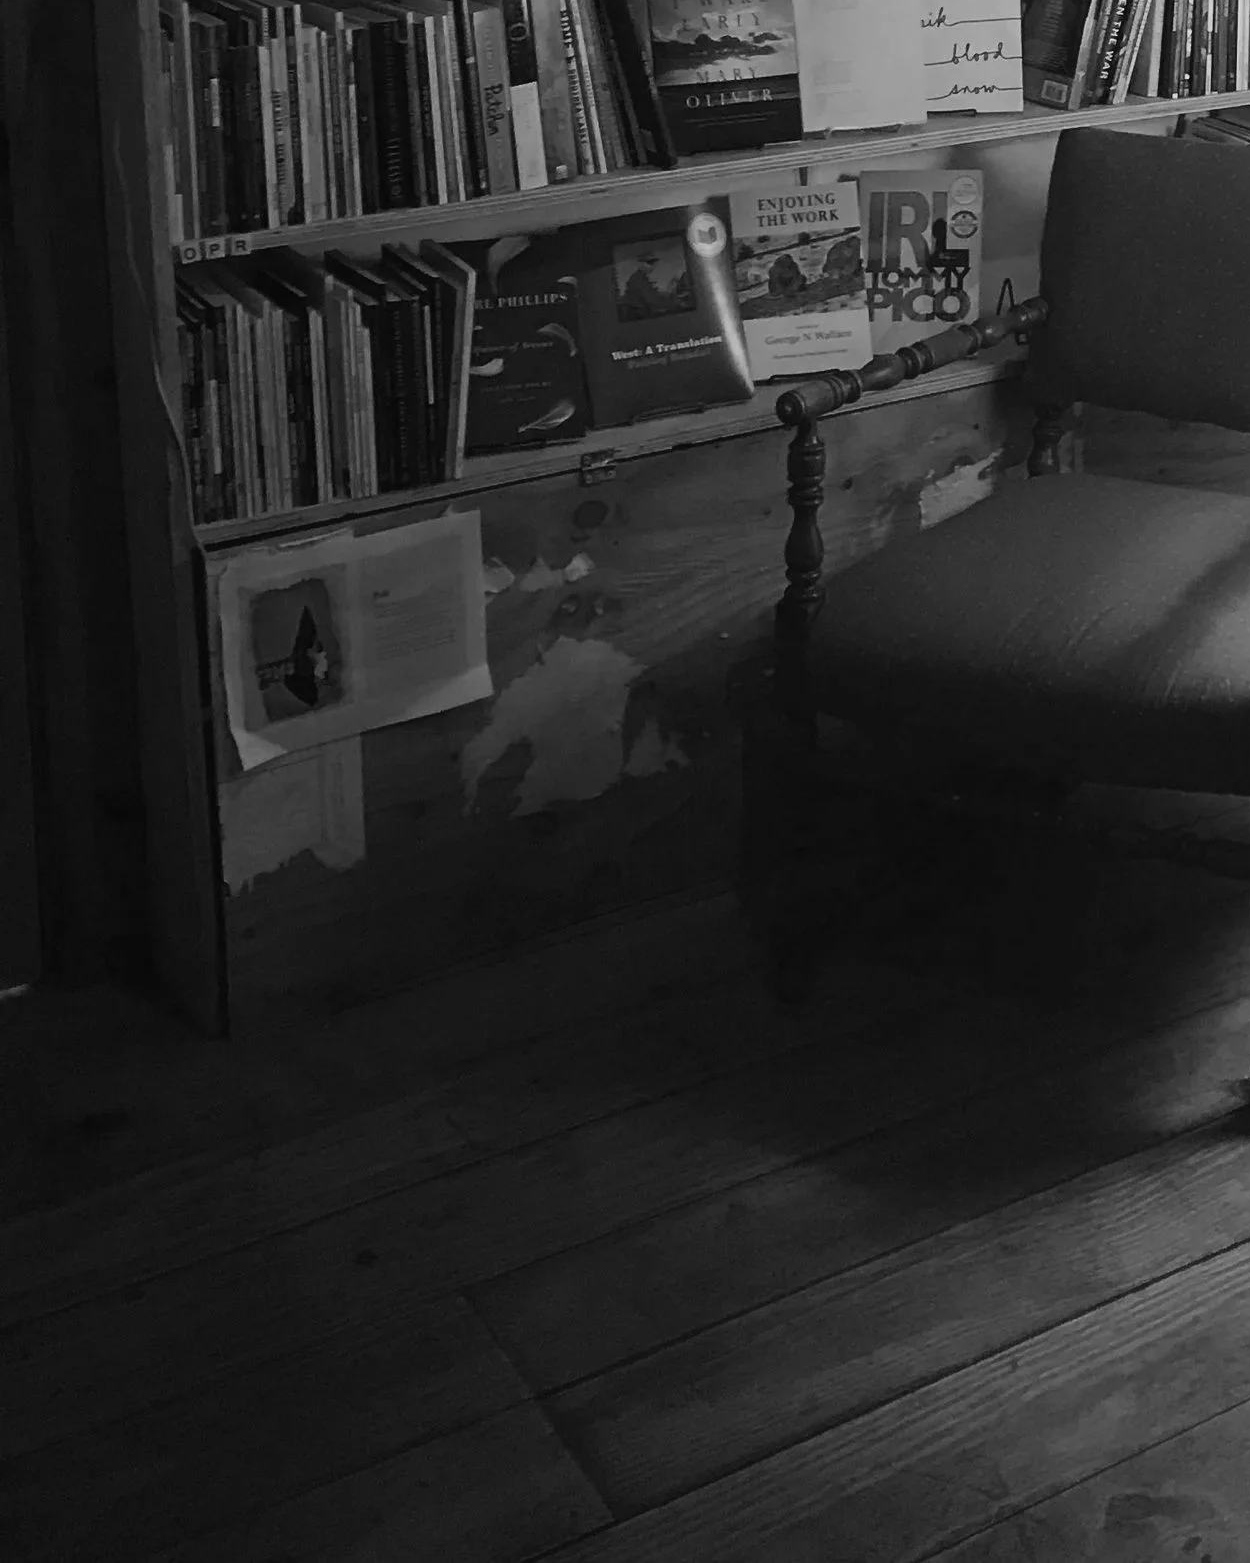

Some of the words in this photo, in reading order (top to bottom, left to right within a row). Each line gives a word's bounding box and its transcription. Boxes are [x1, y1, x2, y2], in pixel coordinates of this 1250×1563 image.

[681, 12, 761, 31] EARLY
[1107, 21, 1122, 46] THE
[951, 42, 1005, 65] blood
[695, 66, 758, 83] MARY
[1100, 50, 1115, 80] WAR
[686, 88, 773, 109] OLIVER
[950, 84, 998, 95] snow
[756, 192, 836, 213] ENJOYING
[755, 214, 788, 228] THE
[791, 209, 839, 224] WORK
[867, 190, 971, 271] IRL
[183, 247, 197, 260] O
[209, 243, 220, 255] P
[235, 239, 247, 252] R
[866, 267, 971, 291] TOMMY
[473, 298, 494, 310] RL
[497, 293, 569, 308] PHILLIPS
[865, 287, 971, 322] PICO
[645, 345, 654, 356] A
[655, 335, 723, 354] Translation
